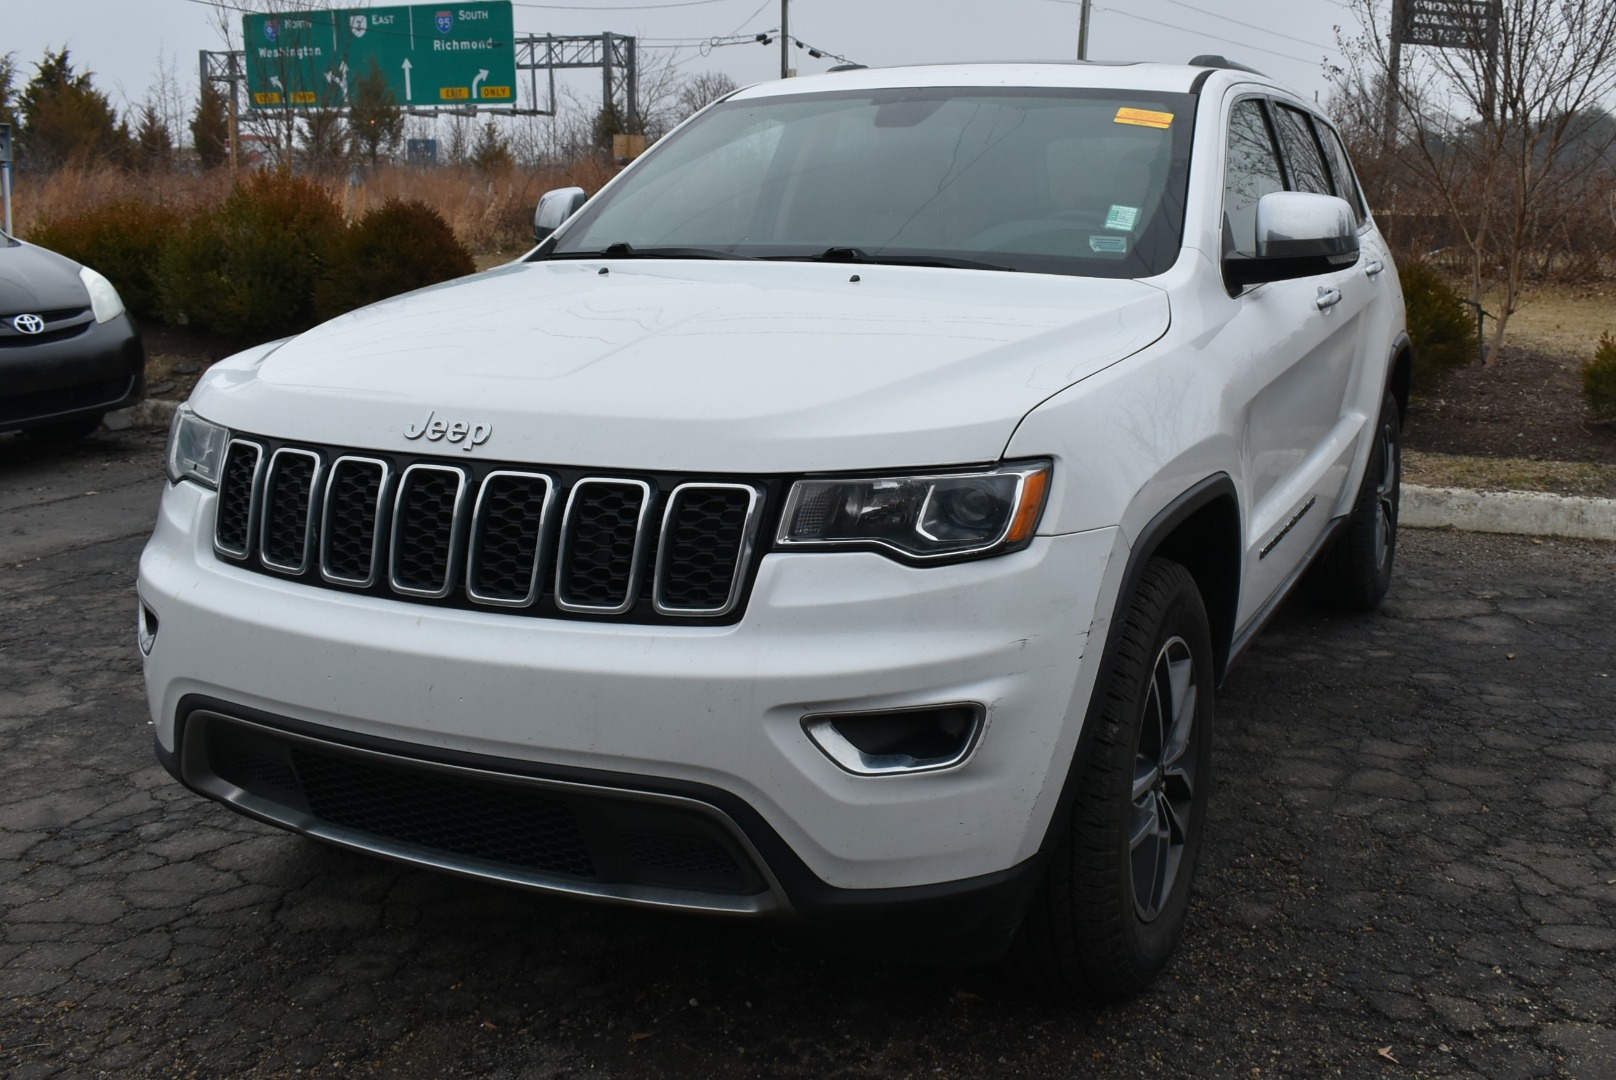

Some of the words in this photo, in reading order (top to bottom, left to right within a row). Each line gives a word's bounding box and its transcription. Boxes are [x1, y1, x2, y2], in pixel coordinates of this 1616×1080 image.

[371, 14, 394, 25] EAST
[458, 9, 489, 21] SOUTH
[1413, 13, 1488, 29] AVAILBE
[356, 20, 363, 31] 3
[438, 17, 451, 29] 95
[433, 37, 493, 51] Richmond
[258, 46, 321, 59] Washington
[446, 89, 462, 98] EXIT
[484, 87, 506, 97] ONLY
[403, 410, 493, 452] Jeep
